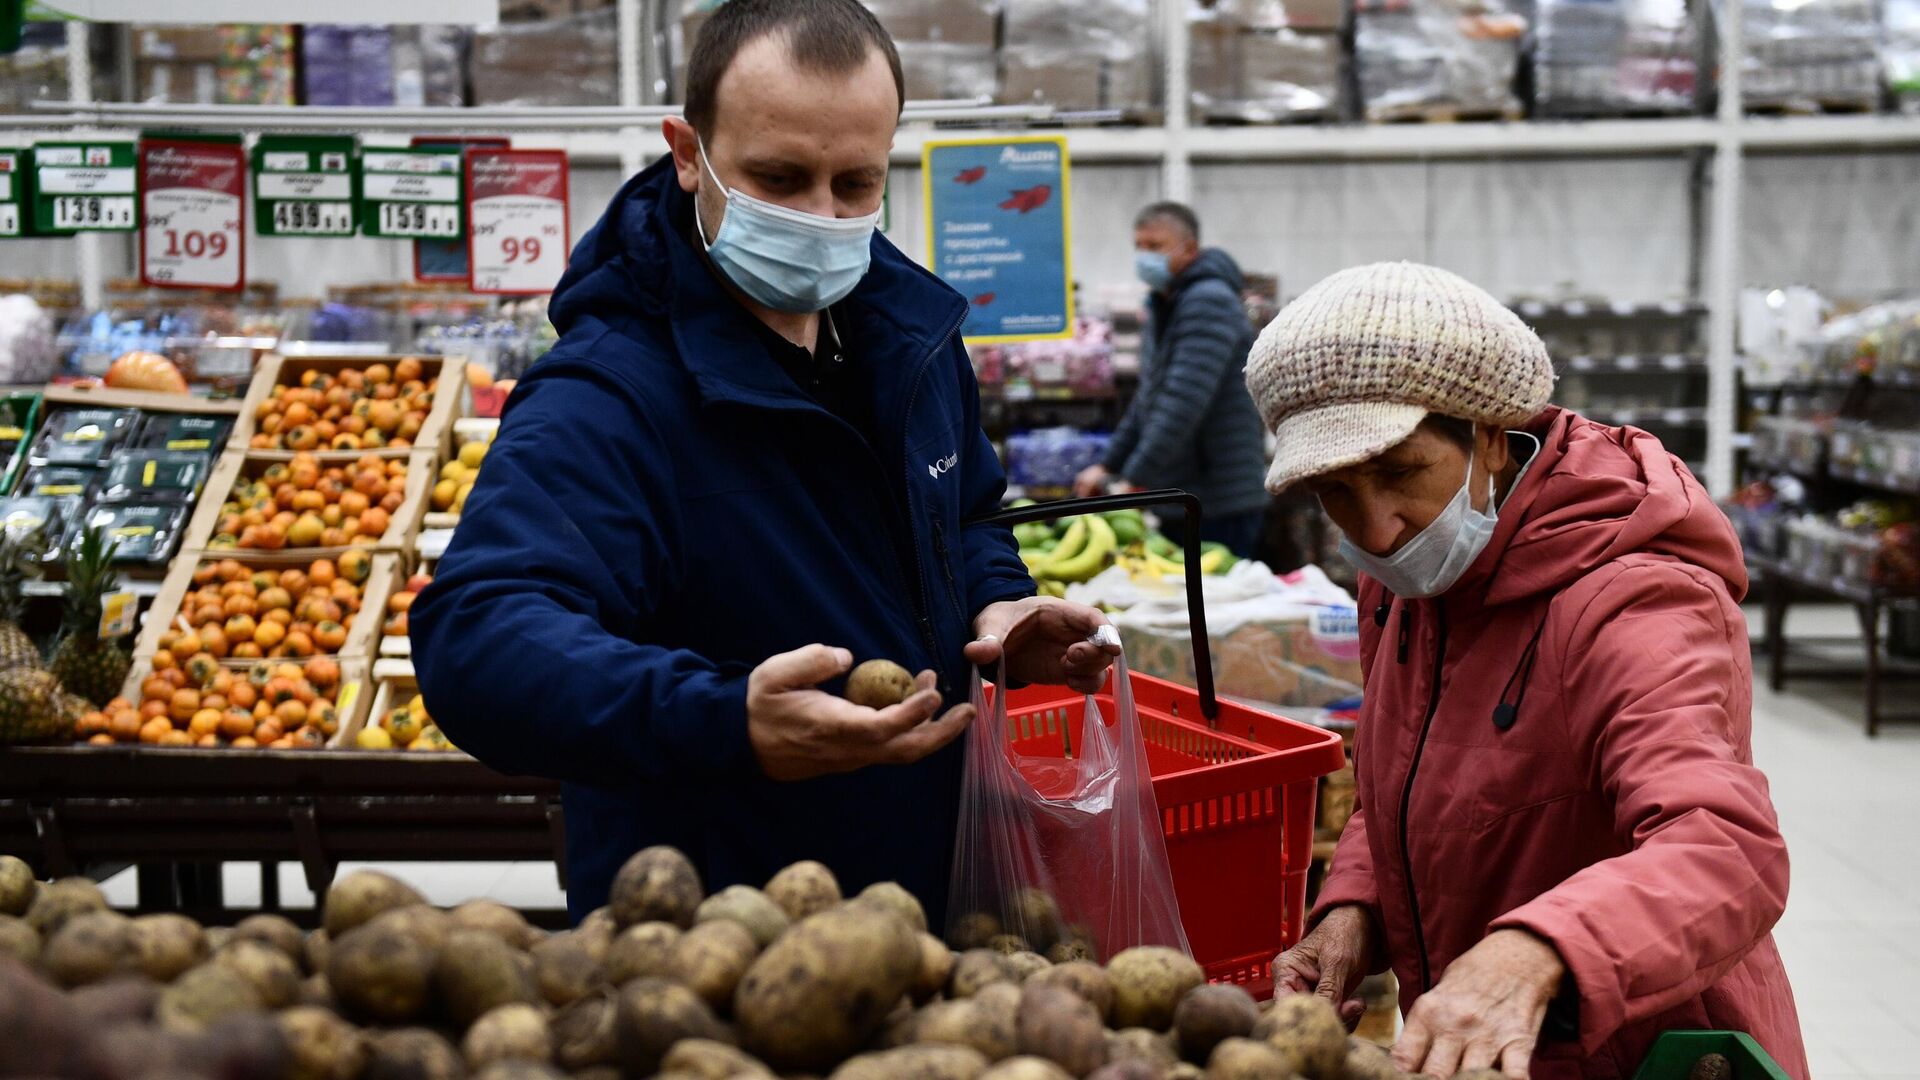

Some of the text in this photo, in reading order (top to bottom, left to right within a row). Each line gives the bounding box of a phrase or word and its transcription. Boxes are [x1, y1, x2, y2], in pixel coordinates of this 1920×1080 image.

[60, 197, 101, 222] 139
[386, 204, 426, 230] 159
[164, 228, 227, 260] 109
[501, 236, 541, 264] 99
